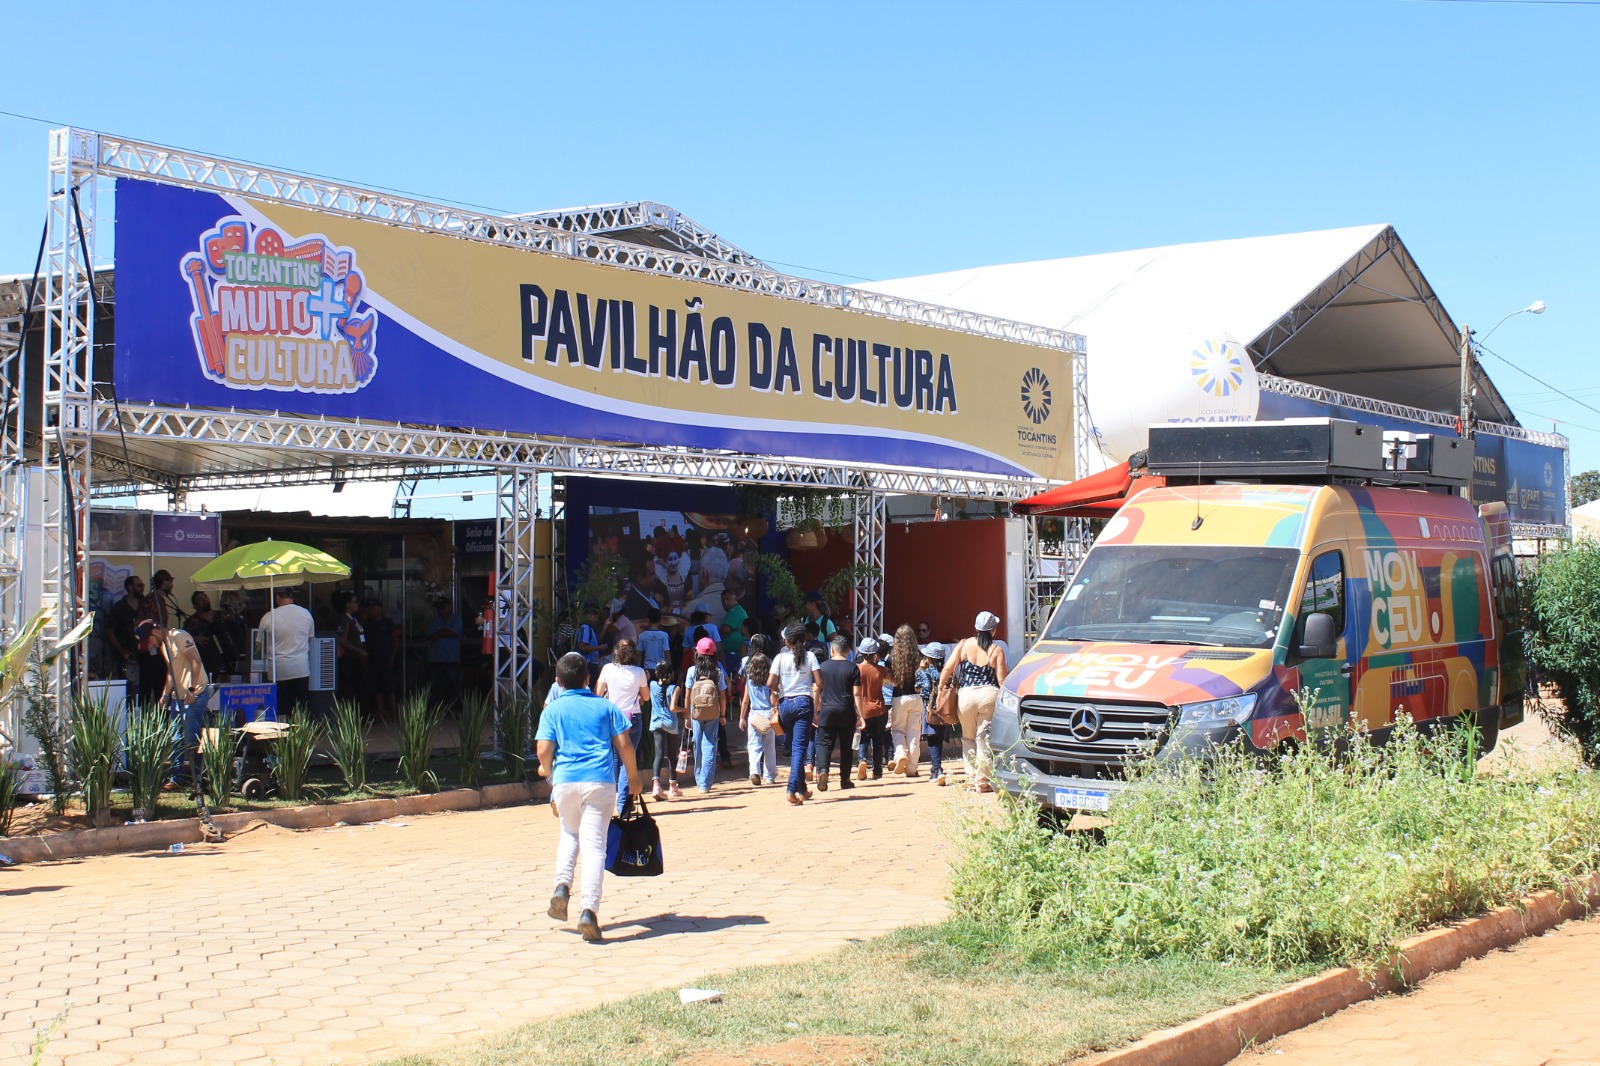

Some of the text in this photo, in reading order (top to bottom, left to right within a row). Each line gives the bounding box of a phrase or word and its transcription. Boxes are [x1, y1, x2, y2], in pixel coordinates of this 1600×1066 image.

[221, 289, 311, 332] MUITO
[228, 337, 355, 385] CULTURA
[519, 283, 958, 414] PAVILHÃO DA CULTURA
[1017, 430, 1057, 444] TOCANTINS
[465, 526, 493, 538] Sala de
[465, 541, 494, 553] Oficinas
[1363, 550, 1418, 592] MOV
[1371, 595, 1422, 645] CEU
[1044, 665, 1156, 690] CEU
[1057, 653, 1179, 669] MOV
